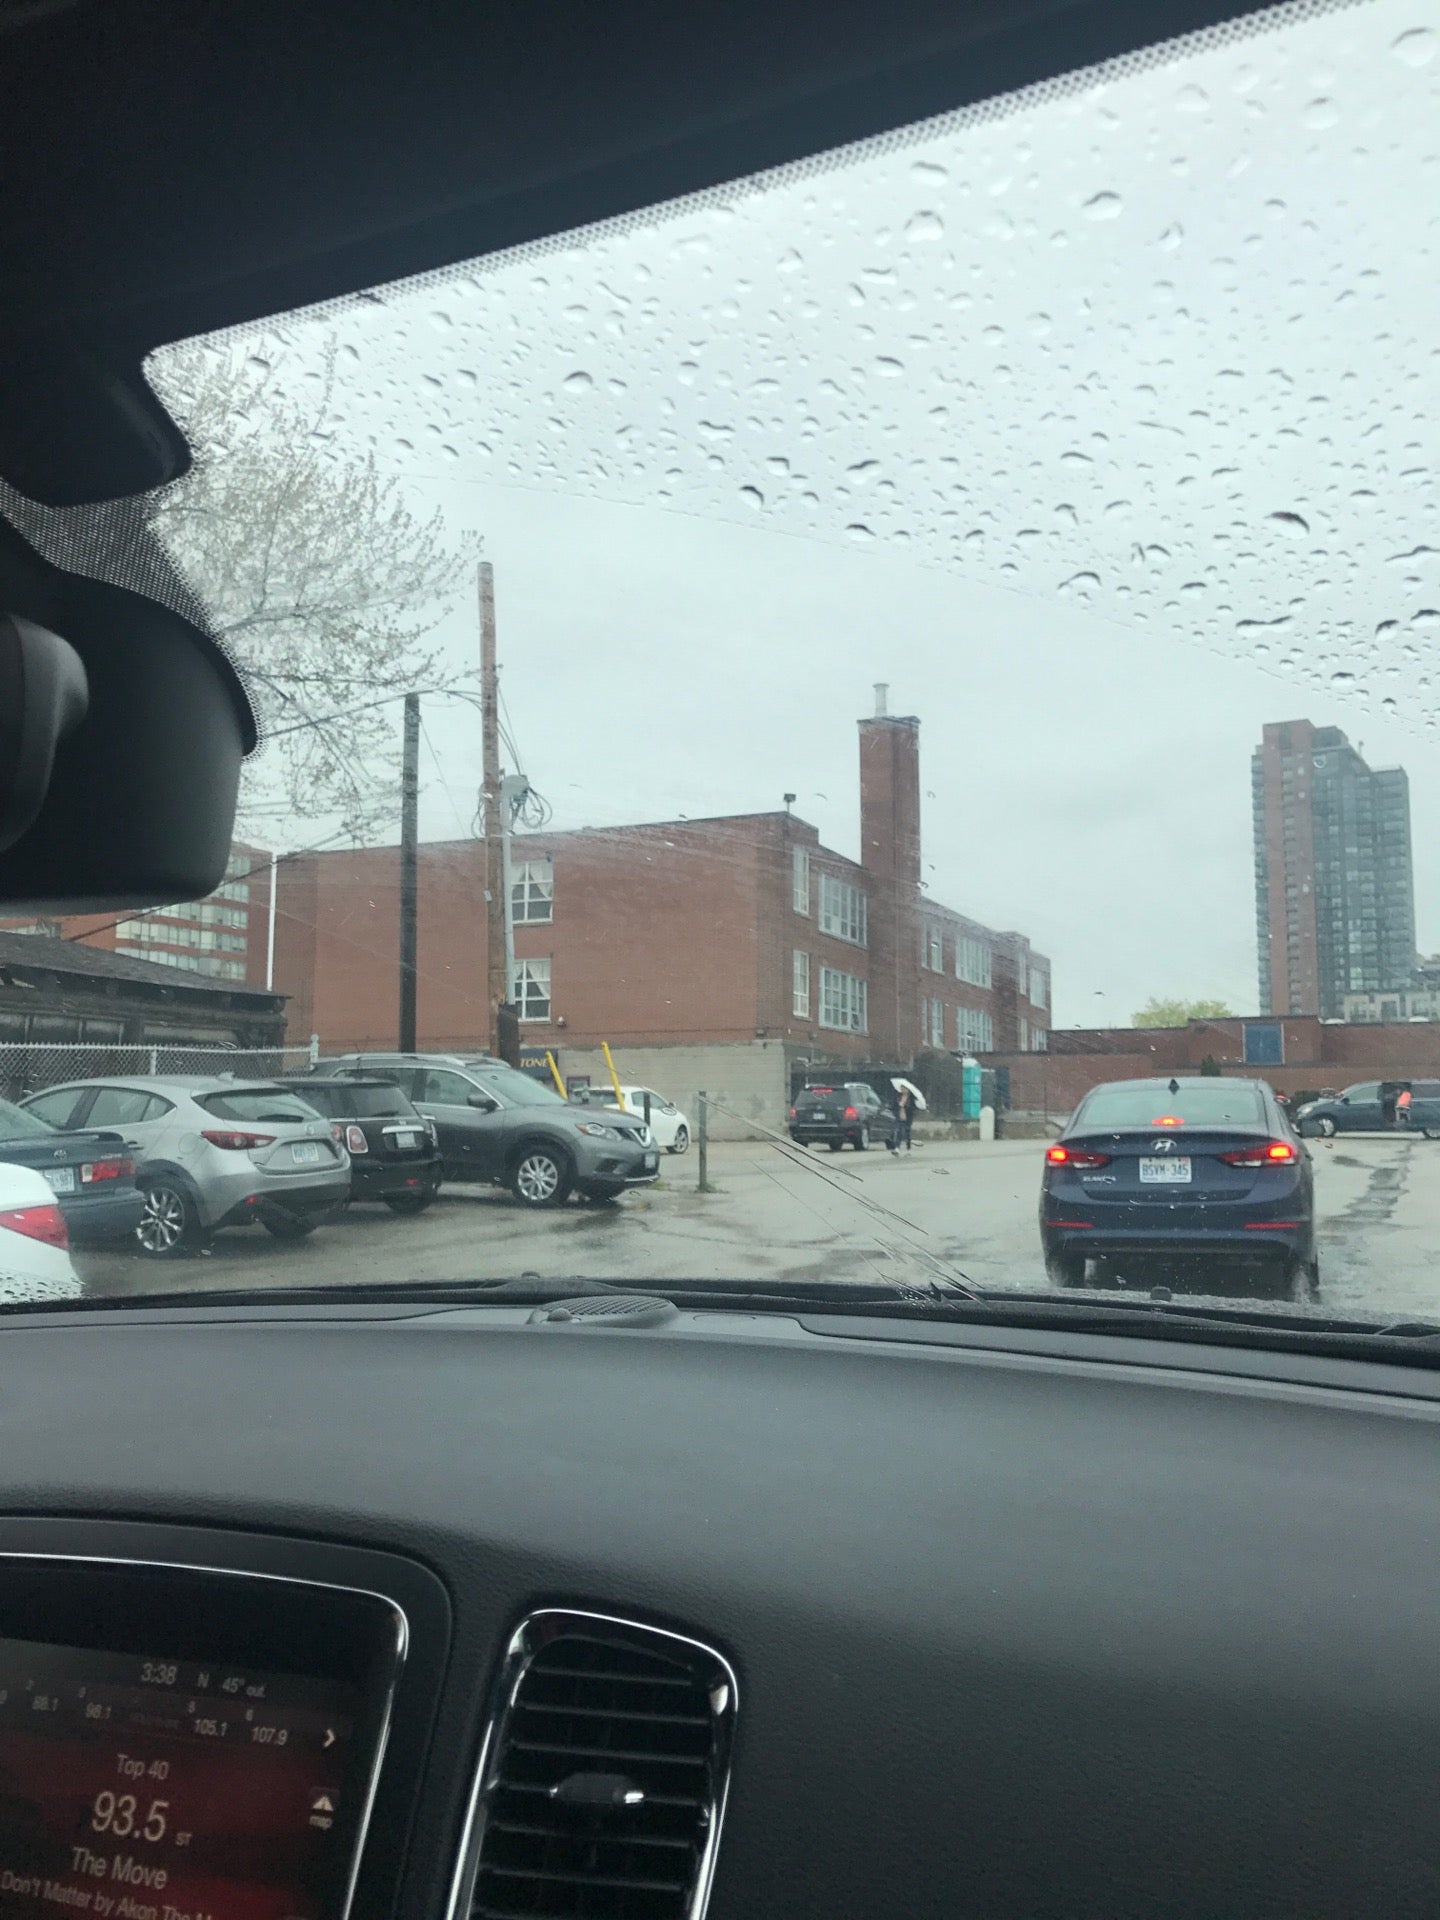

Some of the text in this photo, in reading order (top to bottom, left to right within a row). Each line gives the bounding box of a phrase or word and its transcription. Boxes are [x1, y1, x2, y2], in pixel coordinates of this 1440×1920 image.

[141, 1662, 177, 1685] 3:38
[198, 1672, 209, 1688] N
[194, 1719, 228, 1736] 105.1
[252, 1727, 288, 1745] 107.9
[117, 1753, 169, 1780] Top 40
[92, 1791, 169, 1841] 93.5
[72, 1847, 167, 1889] The Move
[1, 1870, 41, 1897] Don't
[42, 1880, 92, 1908] Matter
[93, 1891, 115, 1916] by
[115, 1897, 157, 1920] Akon
